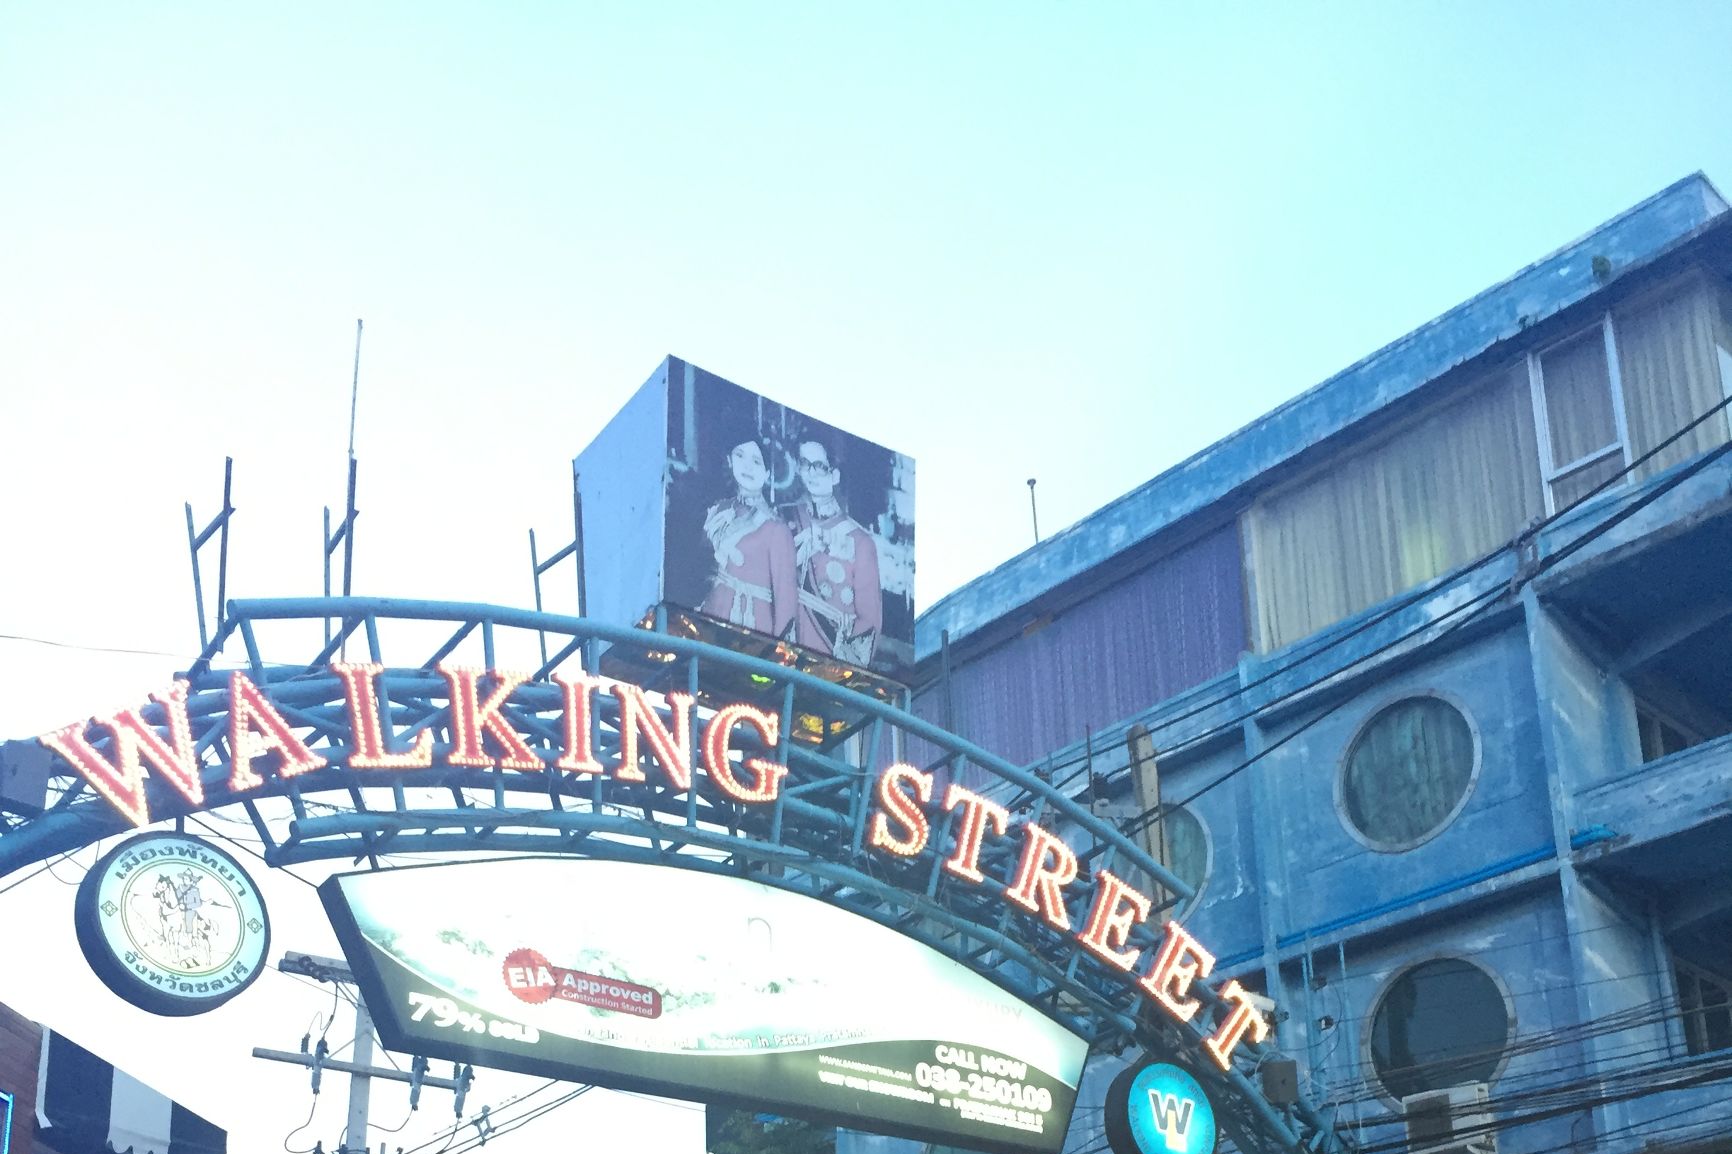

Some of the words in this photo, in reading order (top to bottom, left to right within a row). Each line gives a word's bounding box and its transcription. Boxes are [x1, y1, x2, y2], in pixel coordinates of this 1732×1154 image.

[40, 661, 788, 828] WALKING
[871, 763, 1270, 1072] STREET
[115, 844, 247, 897] เมืองพัทยา
[124, 951, 249, 993] จังหวัดชลบุรี
[508, 966, 557, 988] EIA
[562, 973, 653, 1005] Approved
[408, 991, 486, 1034] 79%
[561, 989, 619, 1008] Construction
[621, 1001, 653, 1016] Started
[935, 1044, 979, 1071] CALL
[981, 1055, 1028, 1081] NOW
